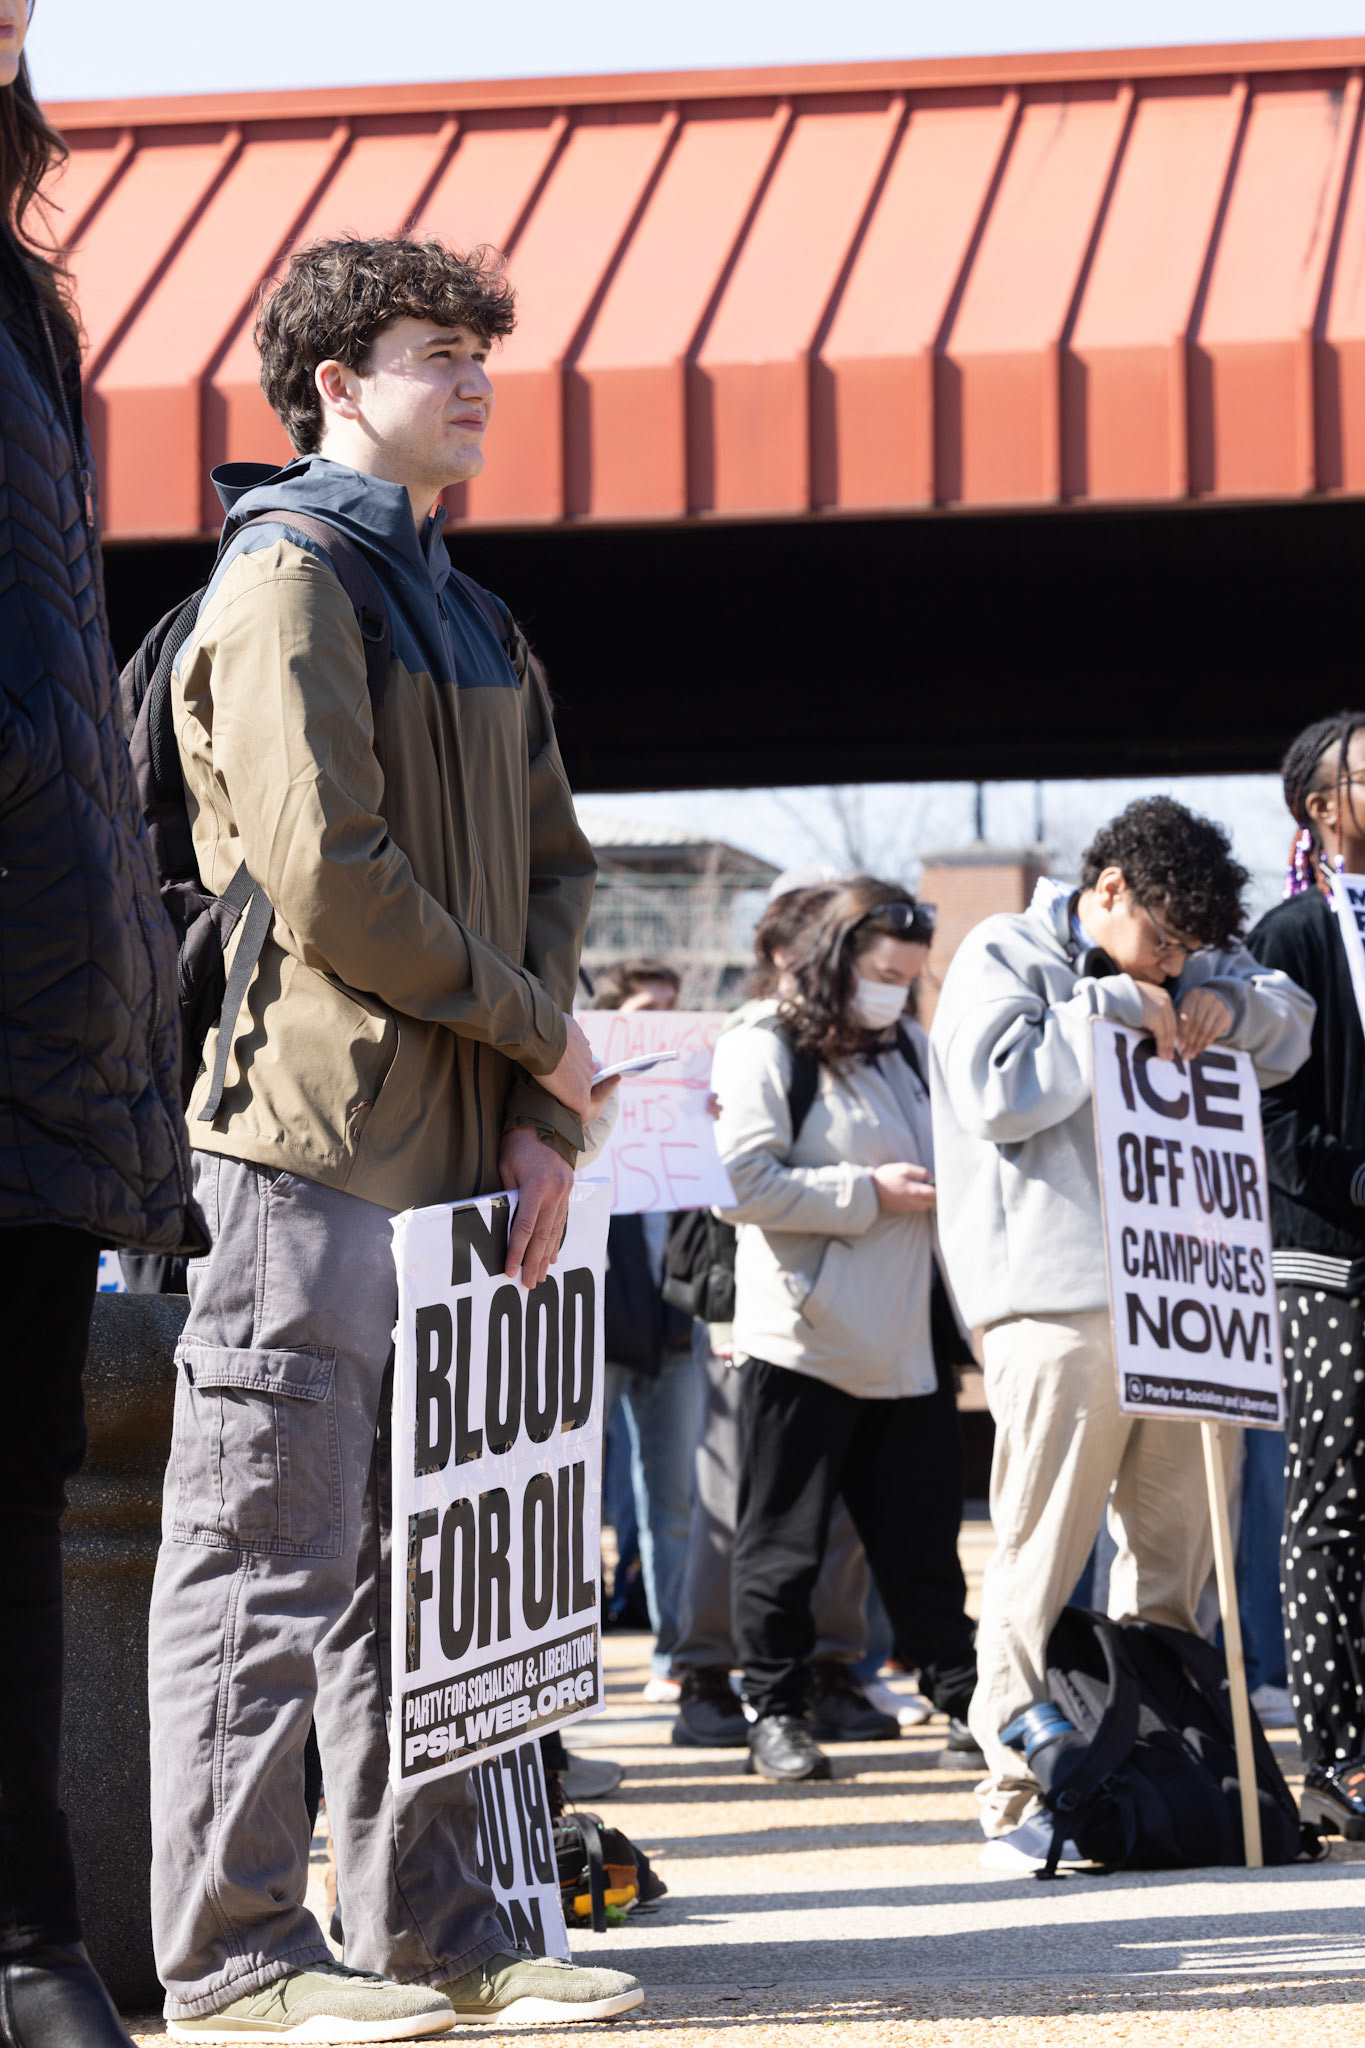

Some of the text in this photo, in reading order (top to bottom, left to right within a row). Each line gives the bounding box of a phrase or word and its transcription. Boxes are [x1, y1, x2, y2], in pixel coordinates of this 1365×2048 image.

[1113, 1031, 1245, 1132] ICE
[1118, 1131, 1263, 1222] OFF OUR
[1122, 1226, 1266, 1298] CAMPUSES
[414, 1267, 596, 1478] BLOOD
[1125, 1292, 1273, 1365] NOW!
[1145, 1382, 1170, 1402] Party
[1170, 1385, 1184, 1400] for
[1185, 1387, 1224, 1405] Socialism
[405, 1460, 597, 1675] FOR OIL
[405, 1633, 595, 1733] PARTY FOR SOCIALISM & LIBERATION
[405, 1671, 595, 1768] PSLWEB.ORG
